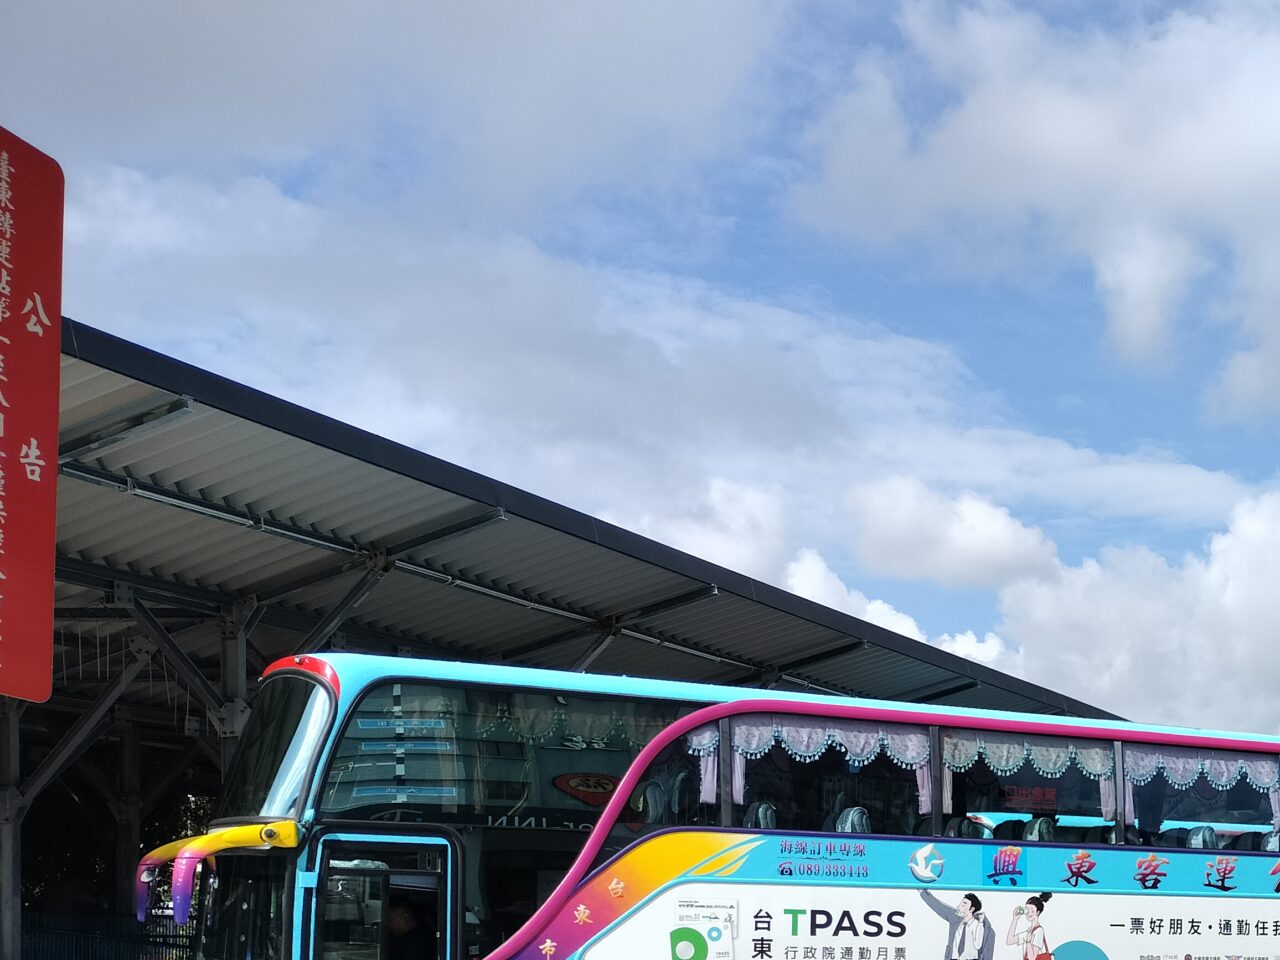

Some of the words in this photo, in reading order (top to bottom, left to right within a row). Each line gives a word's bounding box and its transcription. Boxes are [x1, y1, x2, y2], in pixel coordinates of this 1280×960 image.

[20, 291, 51, 482] 公告
[780, 840, 866, 857] 海線訂車專線
[794, 862, 868, 877] (089)333443
[751, 908, 774, 960] 台東
[783, 908, 907, 938] TPASS
[784, 946, 907, 960] 行政院通勤月票
